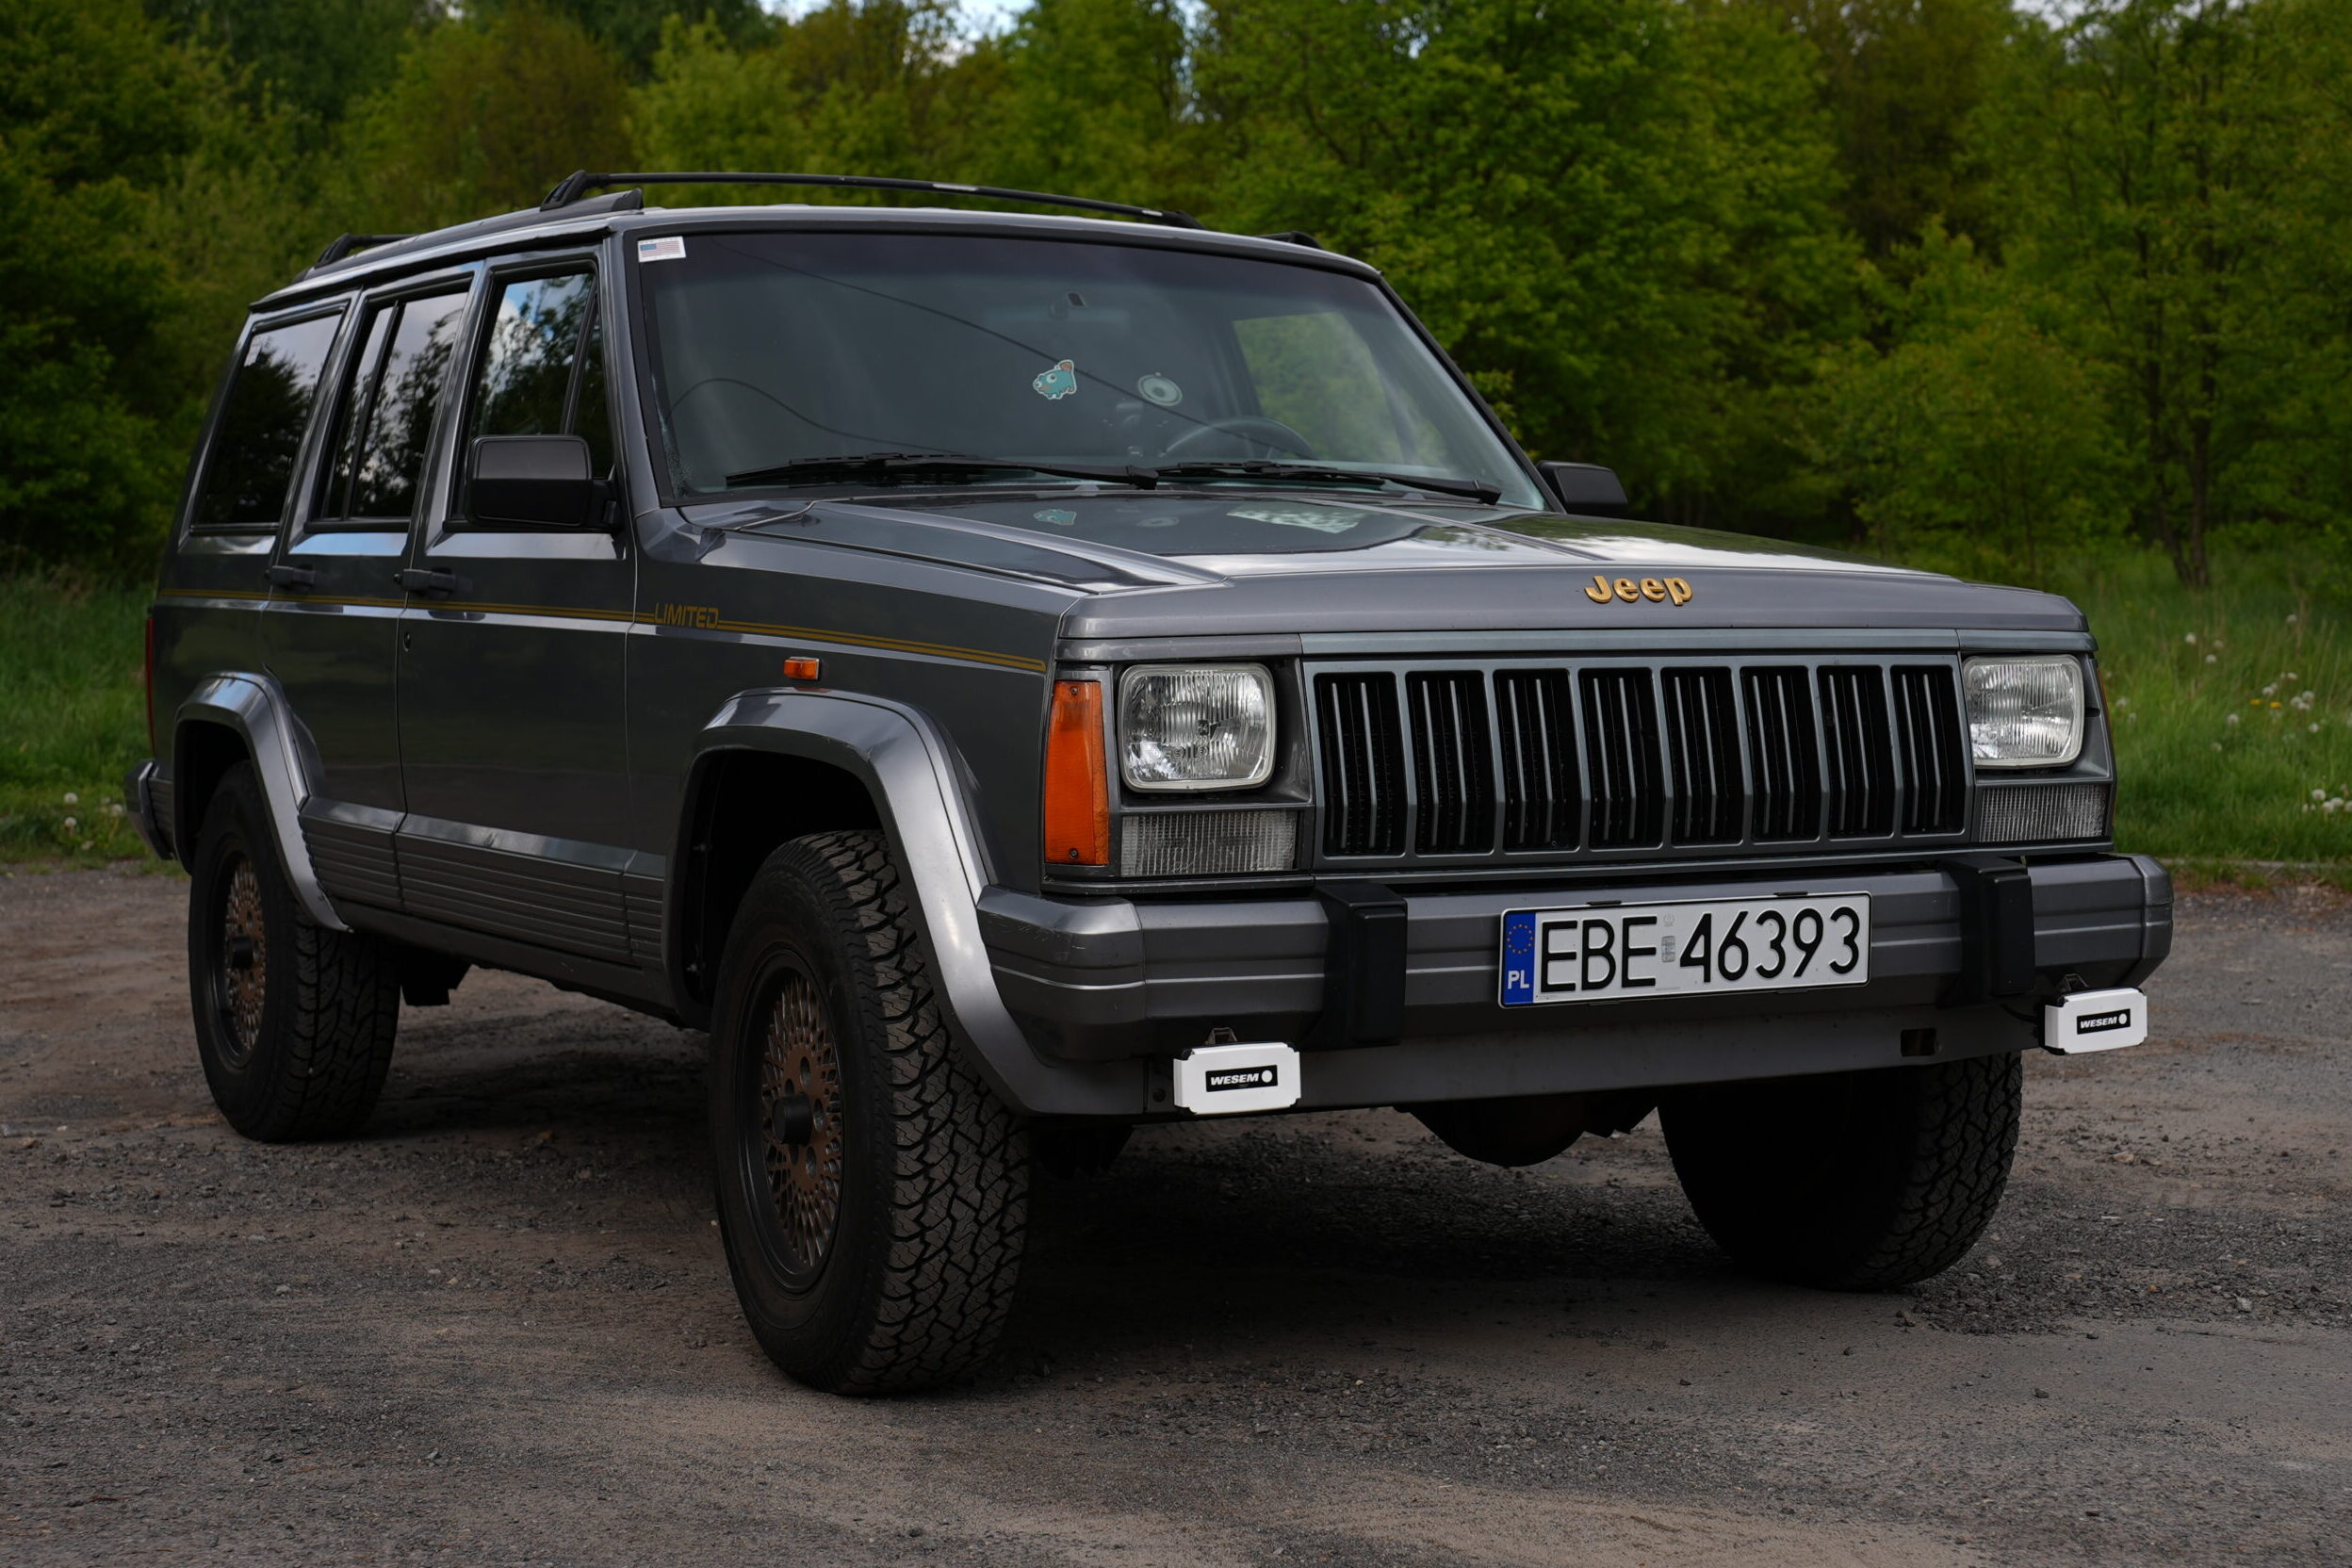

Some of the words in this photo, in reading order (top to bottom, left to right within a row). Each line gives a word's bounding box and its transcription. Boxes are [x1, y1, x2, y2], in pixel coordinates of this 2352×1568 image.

[1584, 575, 1693, 606] Jeep
[654, 602, 719, 629] LIMITED
[1540, 914, 1658, 993] EBE
[1679, 906, 1861, 983] 46393
[1507, 969, 1530, 989] PL
[2080, 1016, 2117, 1029] WESEM
[1210, 1072, 1260, 1086] WESEM
